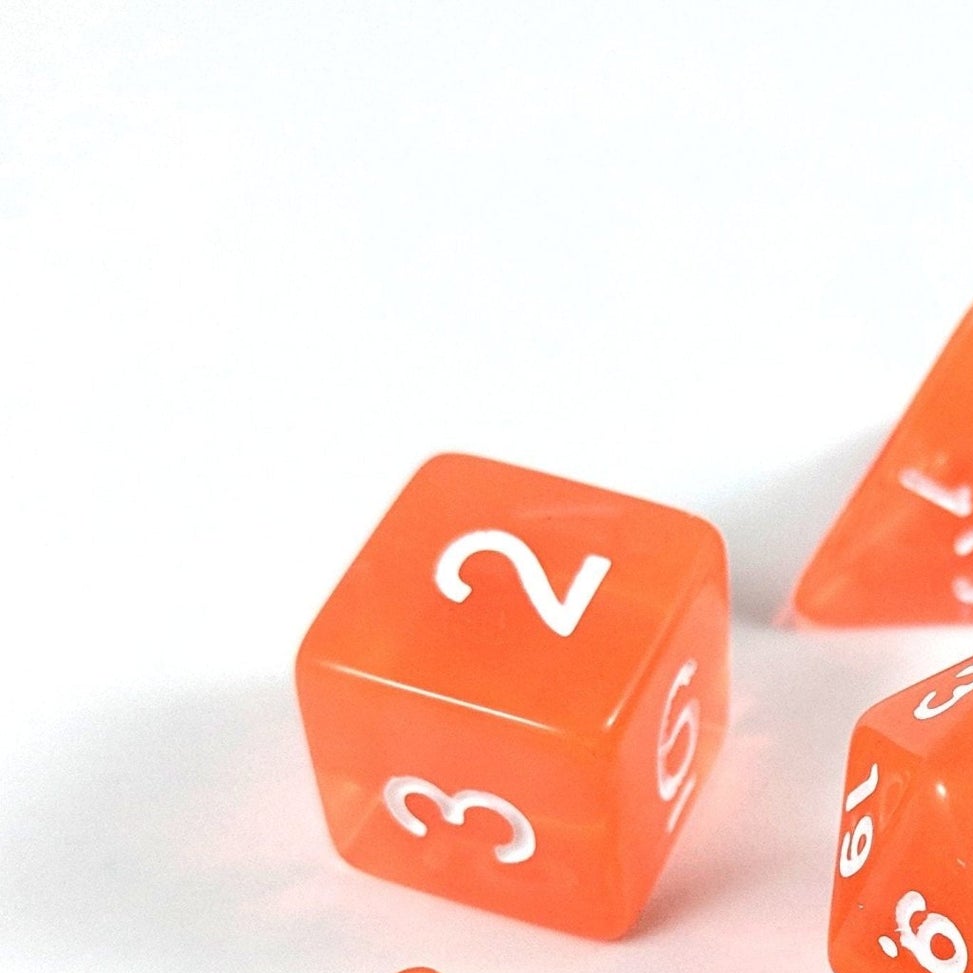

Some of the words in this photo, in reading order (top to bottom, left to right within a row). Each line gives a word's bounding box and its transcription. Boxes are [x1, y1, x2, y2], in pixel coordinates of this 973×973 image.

[900, 467, 973, 518] 1
[434, 528, 612, 637] 2
[384, 775, 536, 865] 3
